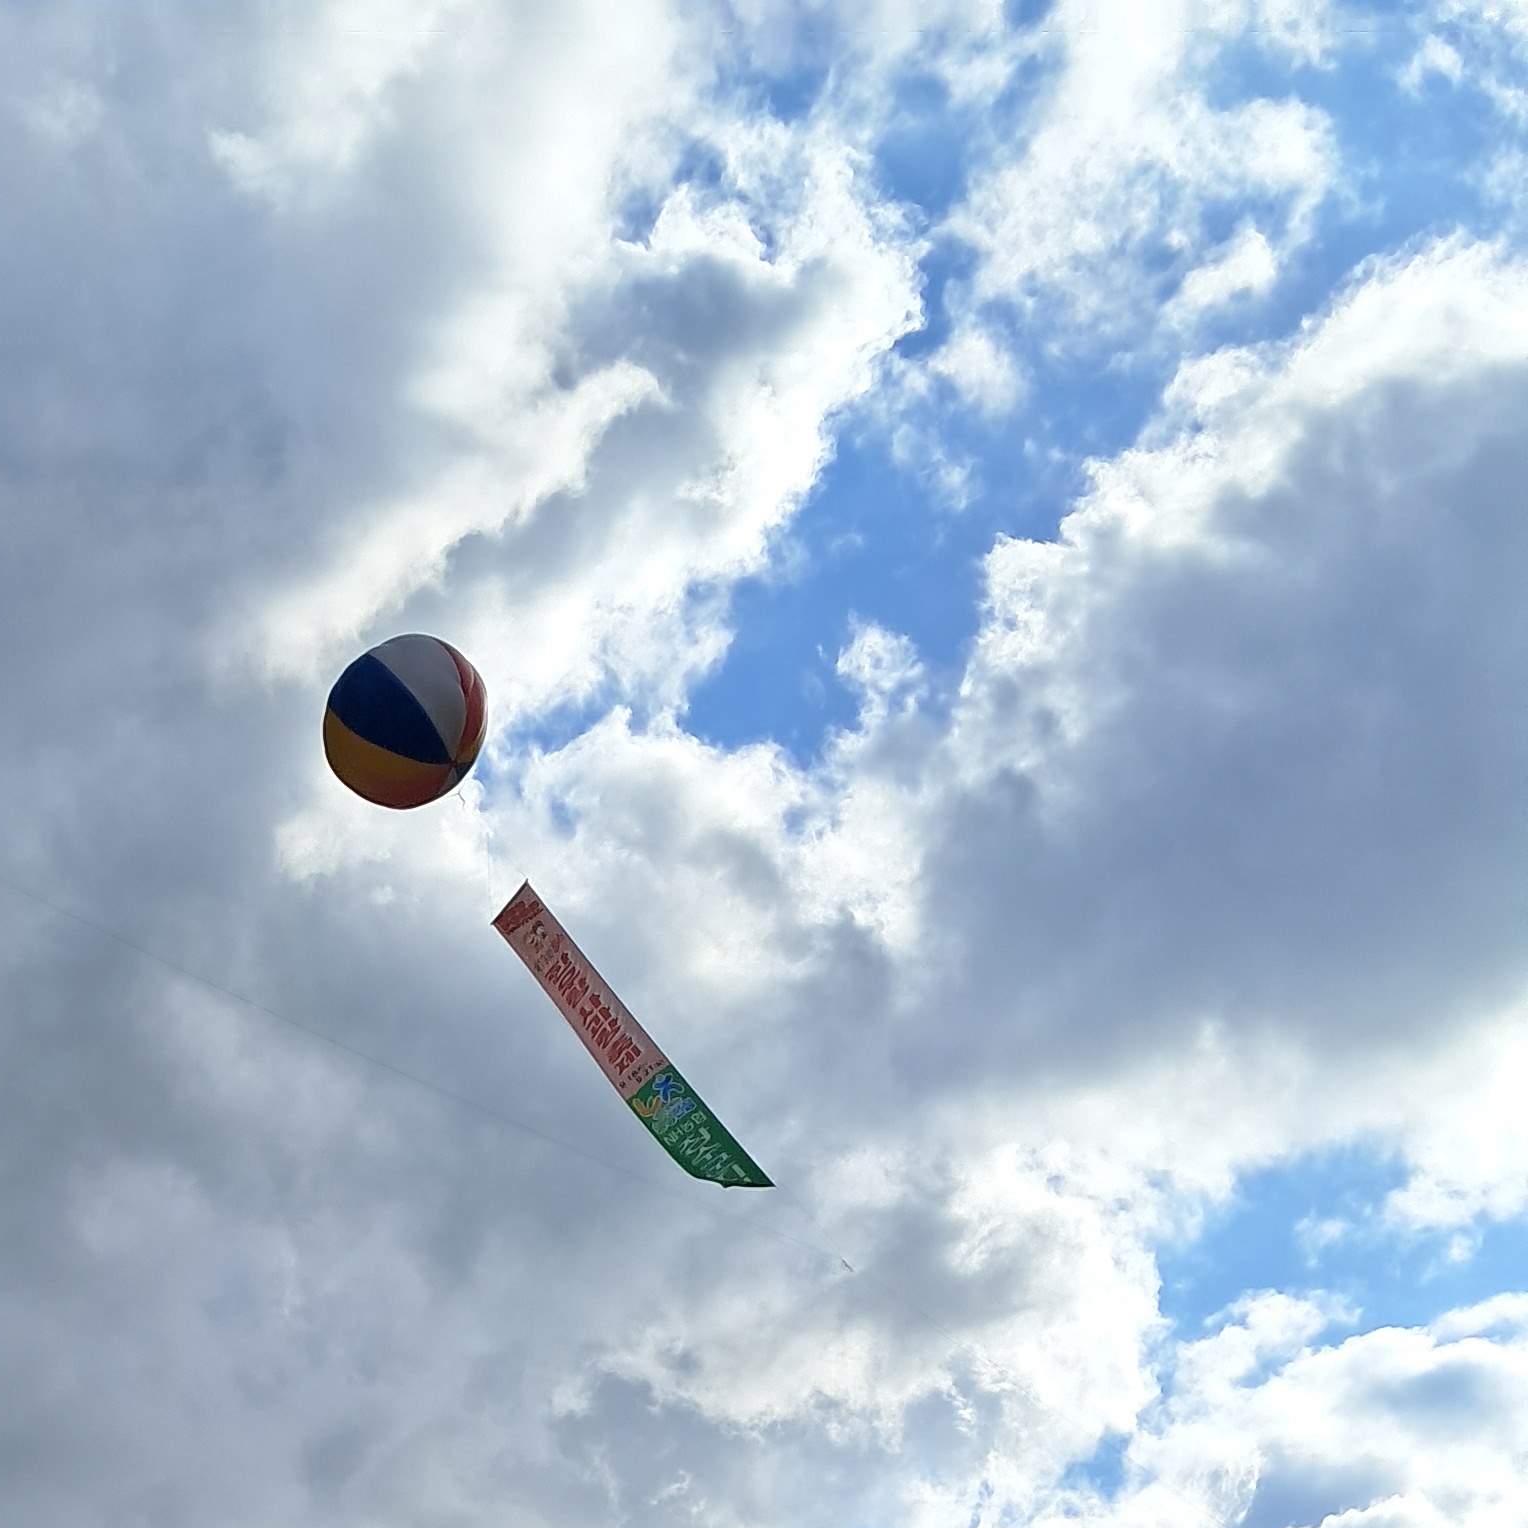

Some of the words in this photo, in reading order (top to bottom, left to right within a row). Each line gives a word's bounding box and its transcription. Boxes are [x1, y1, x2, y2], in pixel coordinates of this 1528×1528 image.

[579, 994, 621, 1049] 사과랑
[608, 1033, 642, 1076] 축제
[664, 1110, 707, 1146] NH농협
